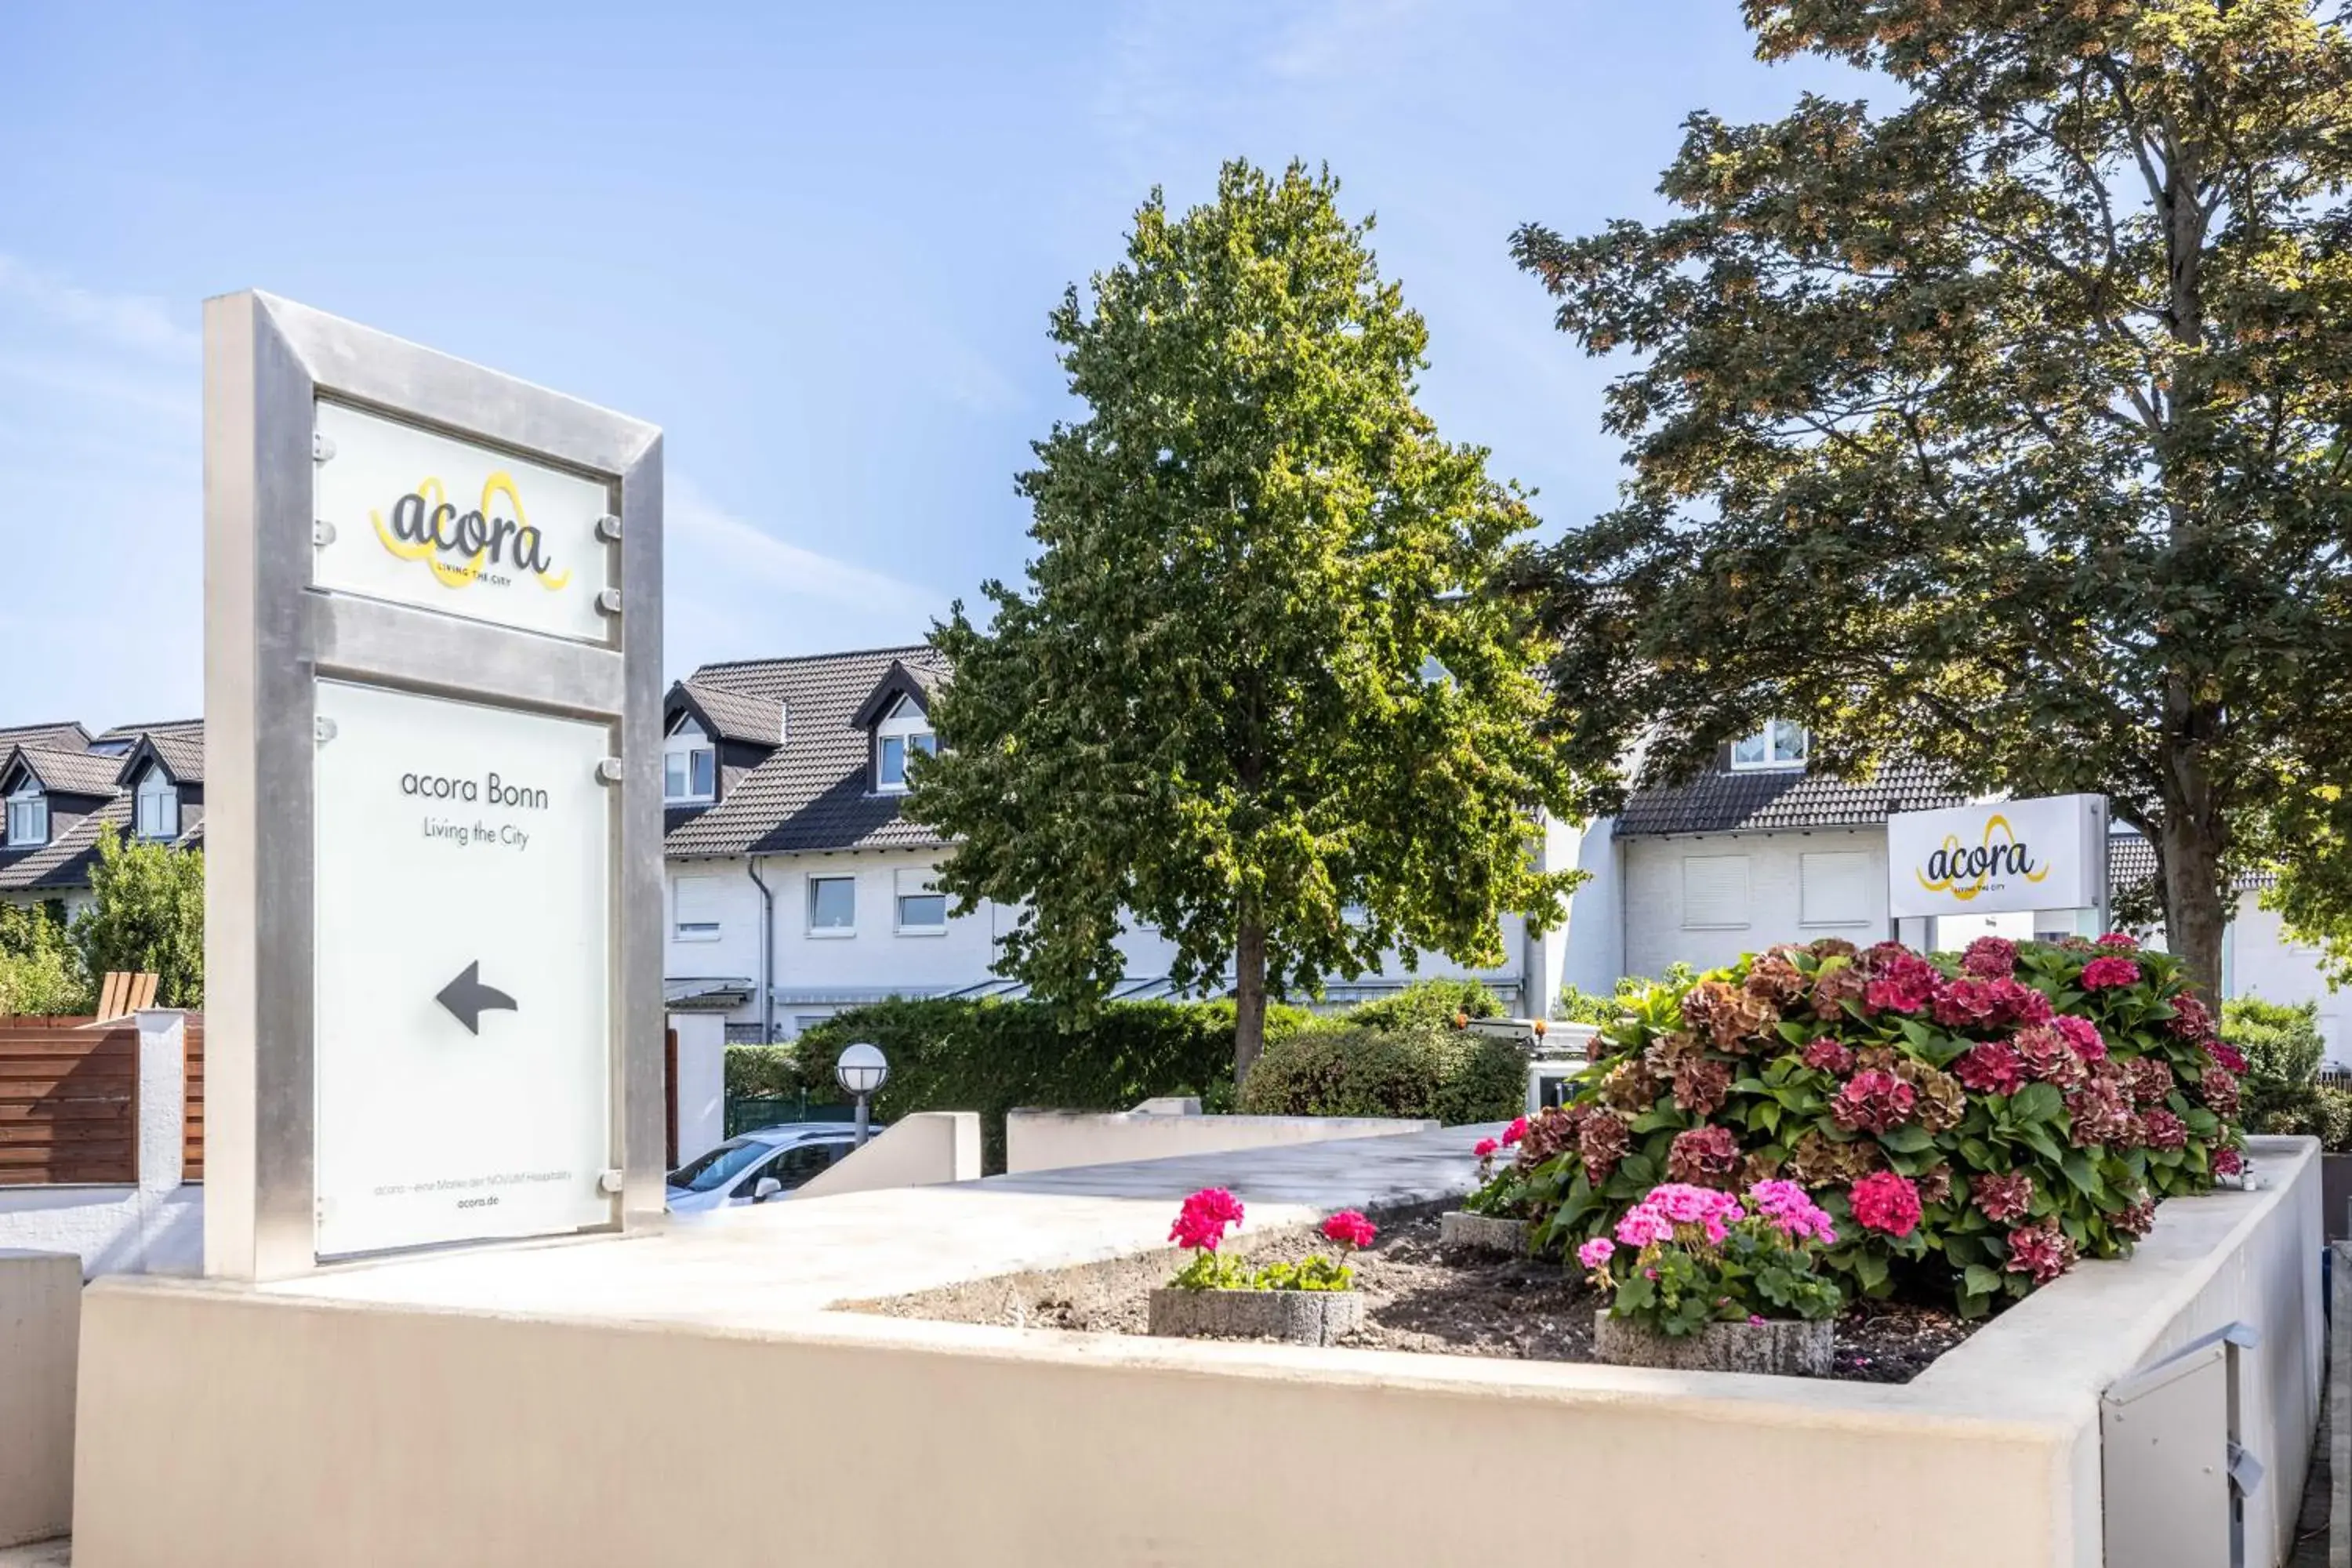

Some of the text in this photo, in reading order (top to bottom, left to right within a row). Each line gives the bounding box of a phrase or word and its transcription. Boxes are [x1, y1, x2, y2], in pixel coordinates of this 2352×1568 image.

[394, 493, 551, 574] acora
[401, 772, 549, 809] acora Bonn
[424, 817, 529, 851] Living the City
[1928, 843, 2034, 880] acora
[457, 1196, 499, 1209] acora.de
